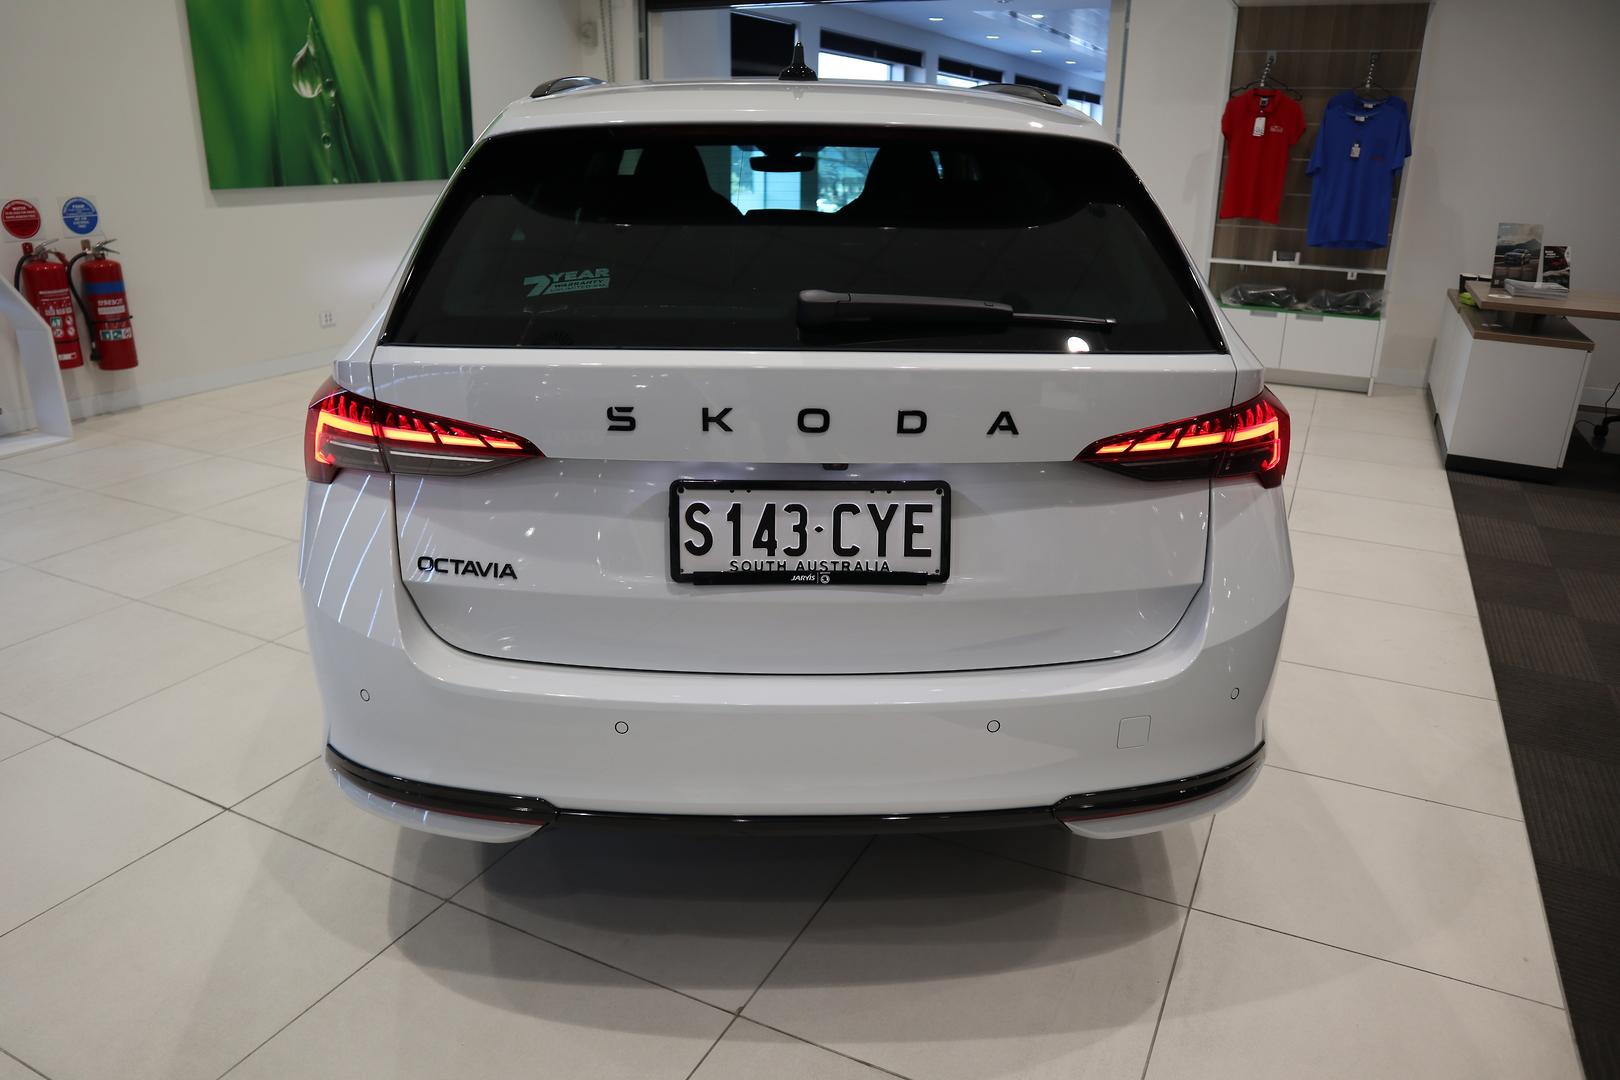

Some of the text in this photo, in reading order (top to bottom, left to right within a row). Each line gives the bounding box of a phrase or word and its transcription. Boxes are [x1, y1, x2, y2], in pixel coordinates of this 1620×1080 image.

[523, 275, 551, 297] 7
[548, 268, 610, 283] YEAR
[606, 406, 1020, 435] SKODA
[417, 556, 518, 580] OCTAVIA
[729, 560, 890, 572] SOUTH AUSTRALIA
